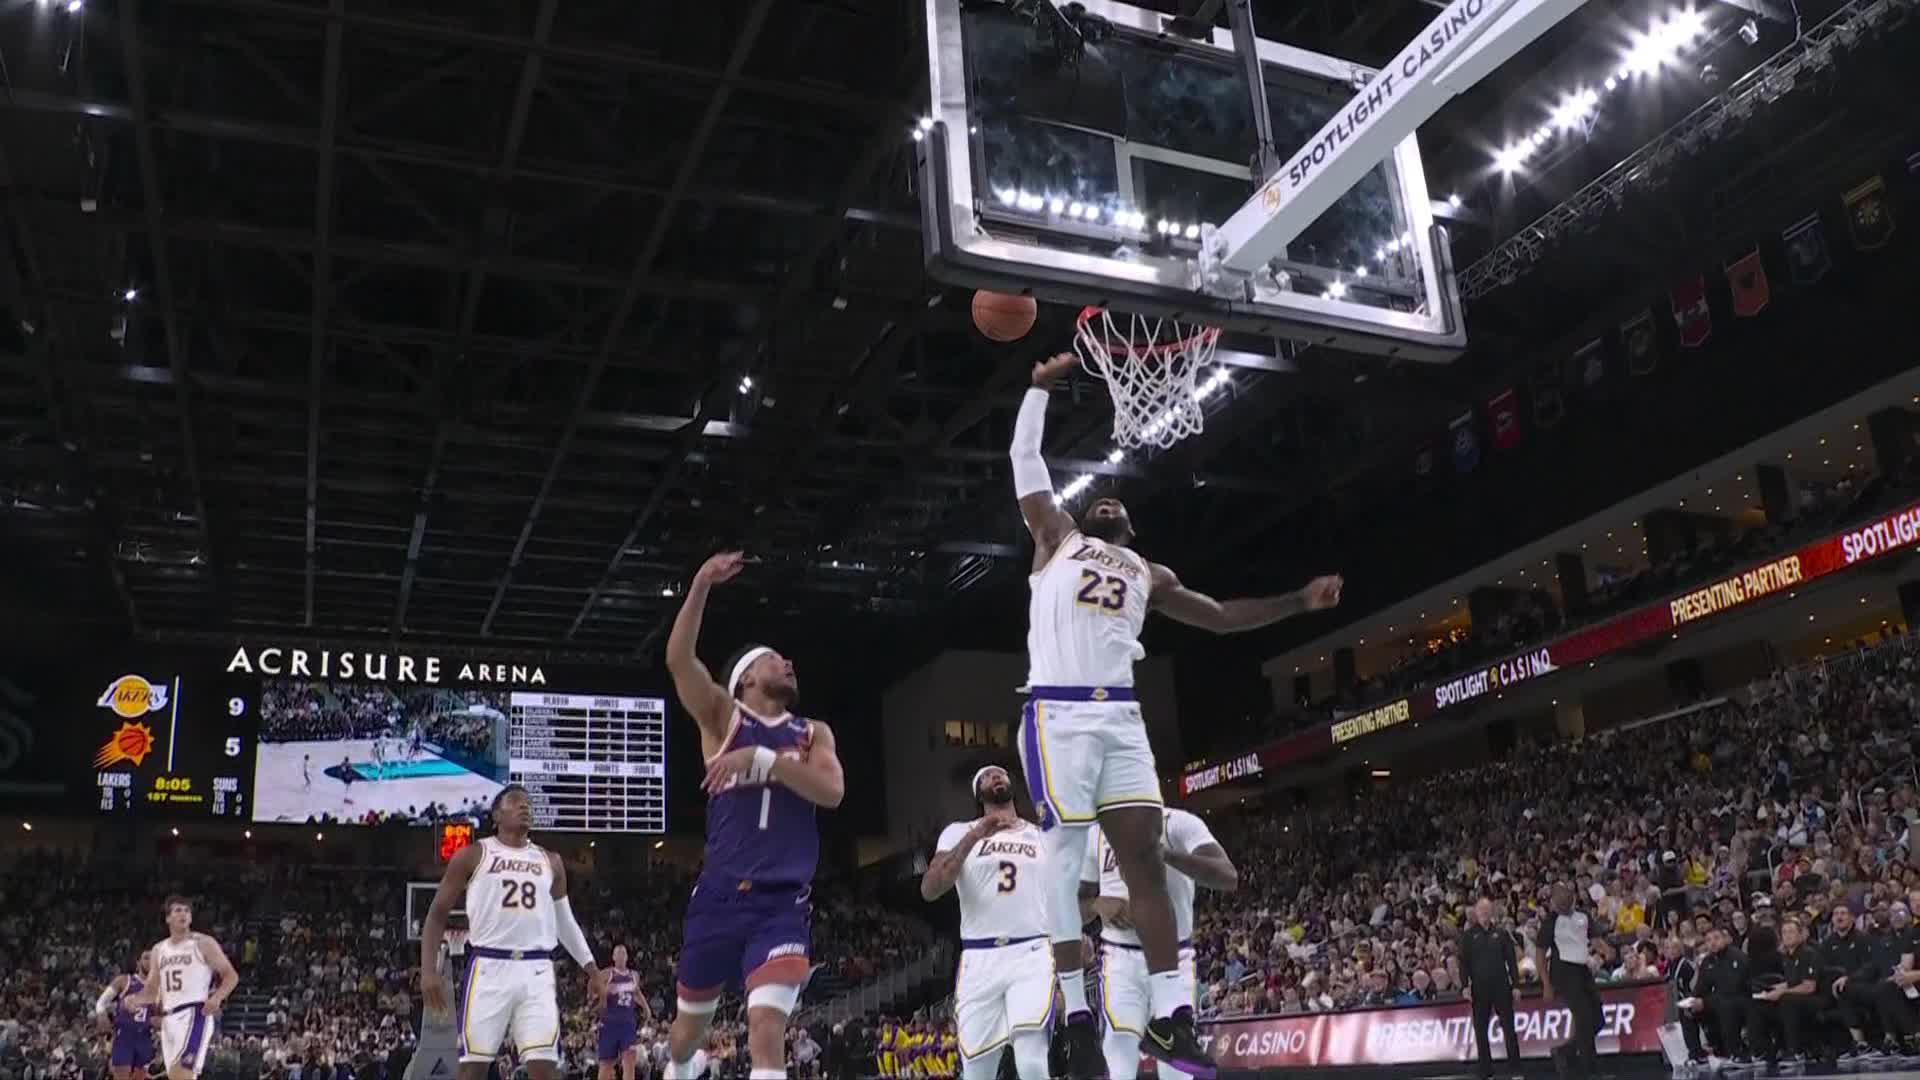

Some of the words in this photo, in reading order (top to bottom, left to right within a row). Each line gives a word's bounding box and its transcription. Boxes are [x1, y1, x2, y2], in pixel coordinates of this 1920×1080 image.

[1289, 75, 1393, 187] SPOTLIGHT
[1402, 0, 1483, 78] CASINO
[1077, 568, 1127, 614] 23
[1670, 577, 1744, 625] PRESENTING
[1744, 555, 1802, 598] PARTNER
[226, 647, 440, 683] ACRISURE
[458, 663, 547, 685] ARENA
[1435, 670, 1488, 709] SPOTLIGHT
[1500, 648, 1550, 686] CASINO
[228, 697, 245, 716] 9
[1331, 711, 1375, 744] PRESENTING
[1374, 699, 1409, 730] PARTNER
[225, 737, 241, 756] 5
[97, 773, 131, 786] LAKERS
[155, 777, 190, 791] 8:05
[213, 777, 238, 791] SUNS
[1185, 766, 1219, 794] SPOTLIGHT
[1226, 753, 1258, 780] CASINO
[758, 787, 771, 830] 1
[977, 839, 1037, 859] LAKERS
[488, 856, 543, 876] LAKERS
[998, 862, 1016, 892] 3
[502, 880, 537, 909] 28
[166, 970, 182, 992] 15
[1368, 1015, 1504, 1046] PRESENTIG
[1513, 1003, 1635, 1041] PARTER
[1235, 1030, 1306, 1057] CASINO
